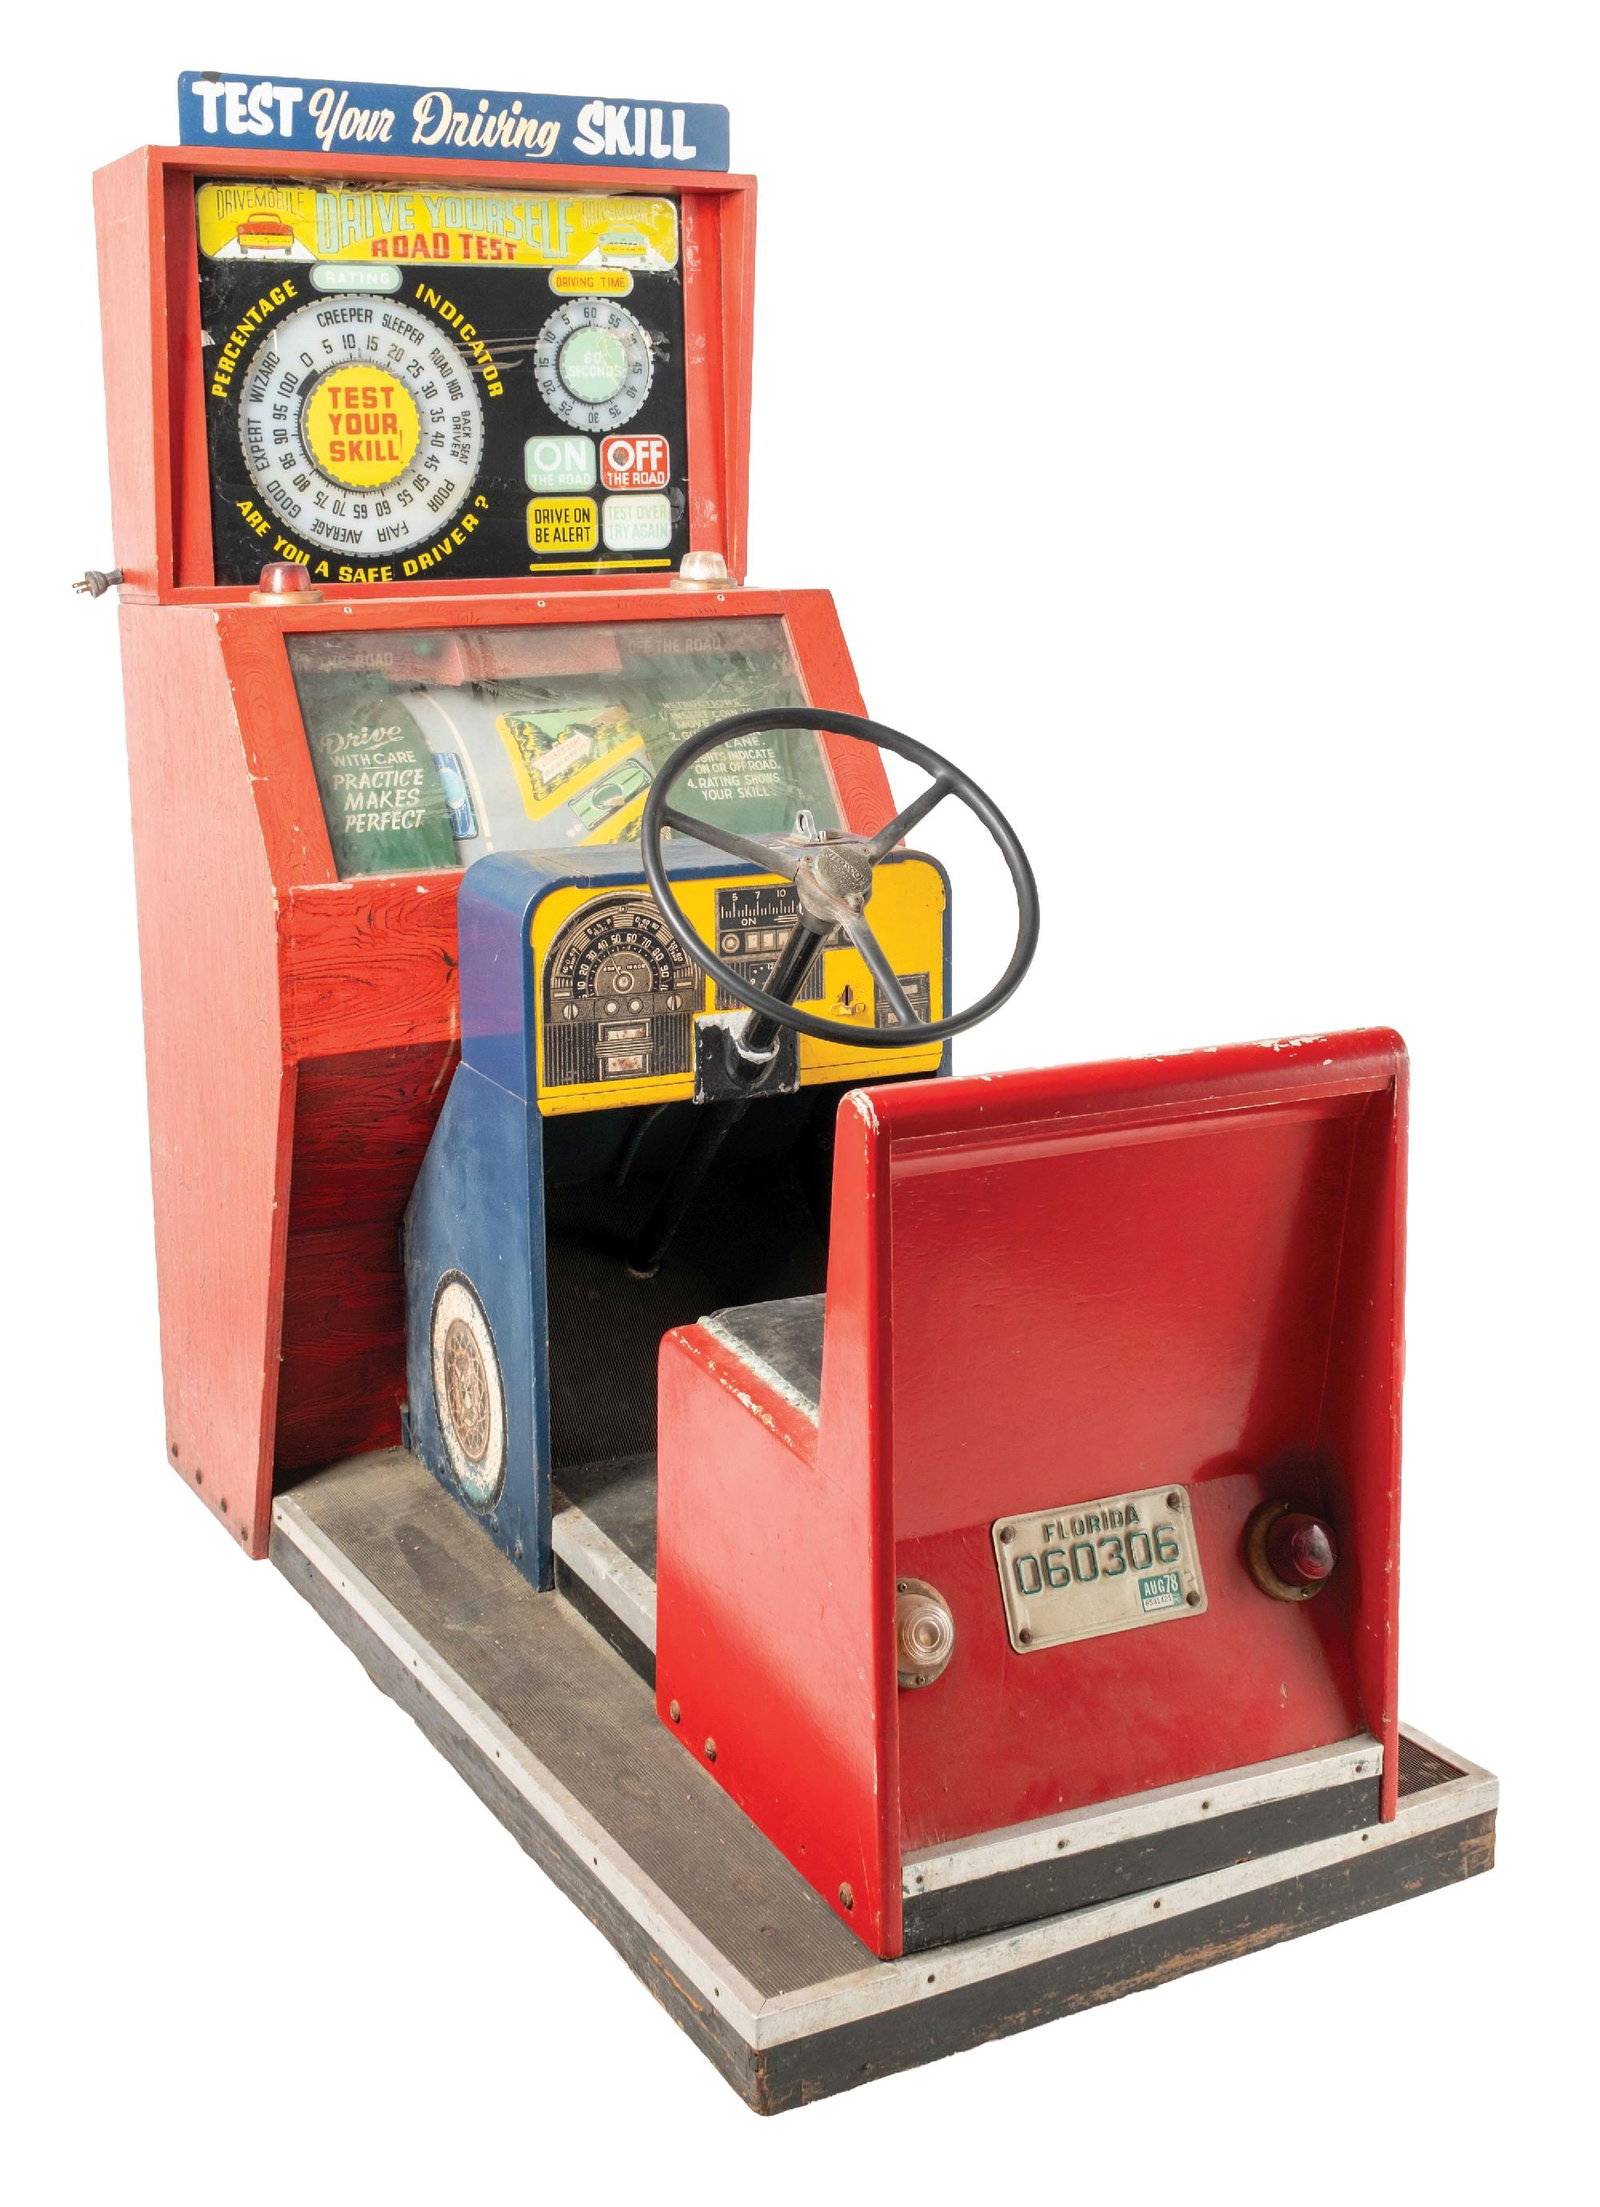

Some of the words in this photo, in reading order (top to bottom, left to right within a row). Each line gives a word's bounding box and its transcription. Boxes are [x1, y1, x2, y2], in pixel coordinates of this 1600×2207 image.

[191, 80, 303, 137] TEST
[308, 87, 396, 152] Your
[412, 91, 561, 157] Driving
[572, 100, 697, 161] SKILL
[316, 192, 415, 254] DRIVE
[424, 194, 575, 259] YOURSELF
[371, 232, 450, 260] ROAD
[458, 232, 517, 260] TEST
[325, 271, 390, 285] RATING
[556, 275, 595, 288] DRIVING
[600, 275, 626, 288] TIME
[316, 307, 374, 328] CREEPER
[561, 314, 571, 326] 5
[583, 307, 598, 319] 60
[608, 314, 621, 328] 55
[211, 279, 299, 398] PERCENTAGE
[415, 283, 504, 397] INDICATOR
[381, 313, 425, 347] SLEEPER
[546, 330, 557, 345] 10
[322, 339, 334, 355] 5
[342, 333, 357, 350] 10
[366, 335, 379, 352] 15
[300, 352, 314, 369] 0
[388, 342, 405, 363] 20
[405, 358, 424, 380] 25
[539, 357, 550, 369] 15
[632, 361, 643, 375] 45
[249, 351, 282, 404] WIZARD
[429, 347, 454, 381] ROAD
[445, 378, 464, 402] HOG
[277, 371, 299, 399] 100
[421, 381, 438, 400] 30
[542, 379, 557, 396] 20
[328, 386, 394, 410] TEST
[272, 403, 289, 421] 95
[429, 408, 446, 424] 35
[557, 402, 573, 416] 25
[608, 404, 623, 420] 35
[328, 413, 398, 436] YOUR
[461, 410, 472, 439] BACK
[588, 412, 600, 425] 30
[248, 418, 270, 472] EXPERT
[273, 428, 289, 446] 90
[430, 431, 446, 449] 40
[451, 415, 461, 458] DRIVER
[329, 440, 399, 462] SKILL
[460, 443, 471, 466] SEAT
[533, 440, 587, 471] ON
[607, 440, 663, 472] OFF
[277, 451, 297, 470] 85
[423, 453, 440, 472] 45
[292, 468, 311, 493] 80
[411, 474, 431, 494] 50
[532, 474, 554, 486] THE
[558, 472, 591, 485] ROAD
[607, 472, 630, 486] THE
[632, 471, 665, 485] ROAD
[266, 479, 302, 519] GOOD
[313, 490, 330, 510] 75
[396, 489, 414, 508] 55
[427, 477, 455, 513] POOR
[331, 499, 347, 517] 70
[353, 504, 368, 520] 65
[375, 499, 392, 517] 60
[534, 507, 571, 524] DRIVE
[574, 507, 591, 523] ON
[606, 504, 633, 521] TEST
[636, 504, 667, 521] OVER
[310, 518, 364, 544] AVERAGE
[377, 520, 409, 543] FAIR
[535, 528, 550, 543] BE
[553, 526, 591, 543] ALERT
[608, 524, 631, 540] TRY
[632, 522, 668, 540] AGAIN
[236, 500, 271, 537] ARE
[273, 535, 311, 566] YOU
[314, 561, 329, 577] A
[339, 566, 393, 582] SAFE
[320, 726, 404, 754] Drive
[330, 753, 372, 767] WITH
[373, 751, 416, 765] CARE
[728, 748, 776, 761] INDICATE
[695, 763, 711, 775] ON
[712, 762, 728, 773] OR
[332, 768, 424, 790] PRACTICE
[699, 775, 741, 789] RATING
[745, 772, 781, 786] SHOWS
[344, 788, 421, 811] MAKES
[702, 789, 734, 801] YOUR
[345, 809, 426, 833] PERFECT
[732, 892, 738, 901] 5
[755, 891, 761, 900] 7
[776, 889, 787, 898] 10
[741, 917, 757, 926] ON
[598, 939, 609, 951] 40
[611, 933, 622, 944] 50
[626, 933, 638, 943] 60
[641, 936, 652, 948] 70
[585, 950, 598, 962] 30
[652, 947, 665, 962] 80
[579, 963, 590, 976] 20
[660, 964, 670, 979] 90
[577, 982, 587, 991] 10
[1043, 1503, 1141, 1543] FLORIDA
[1015, 1524, 1180, 1595] 060306
